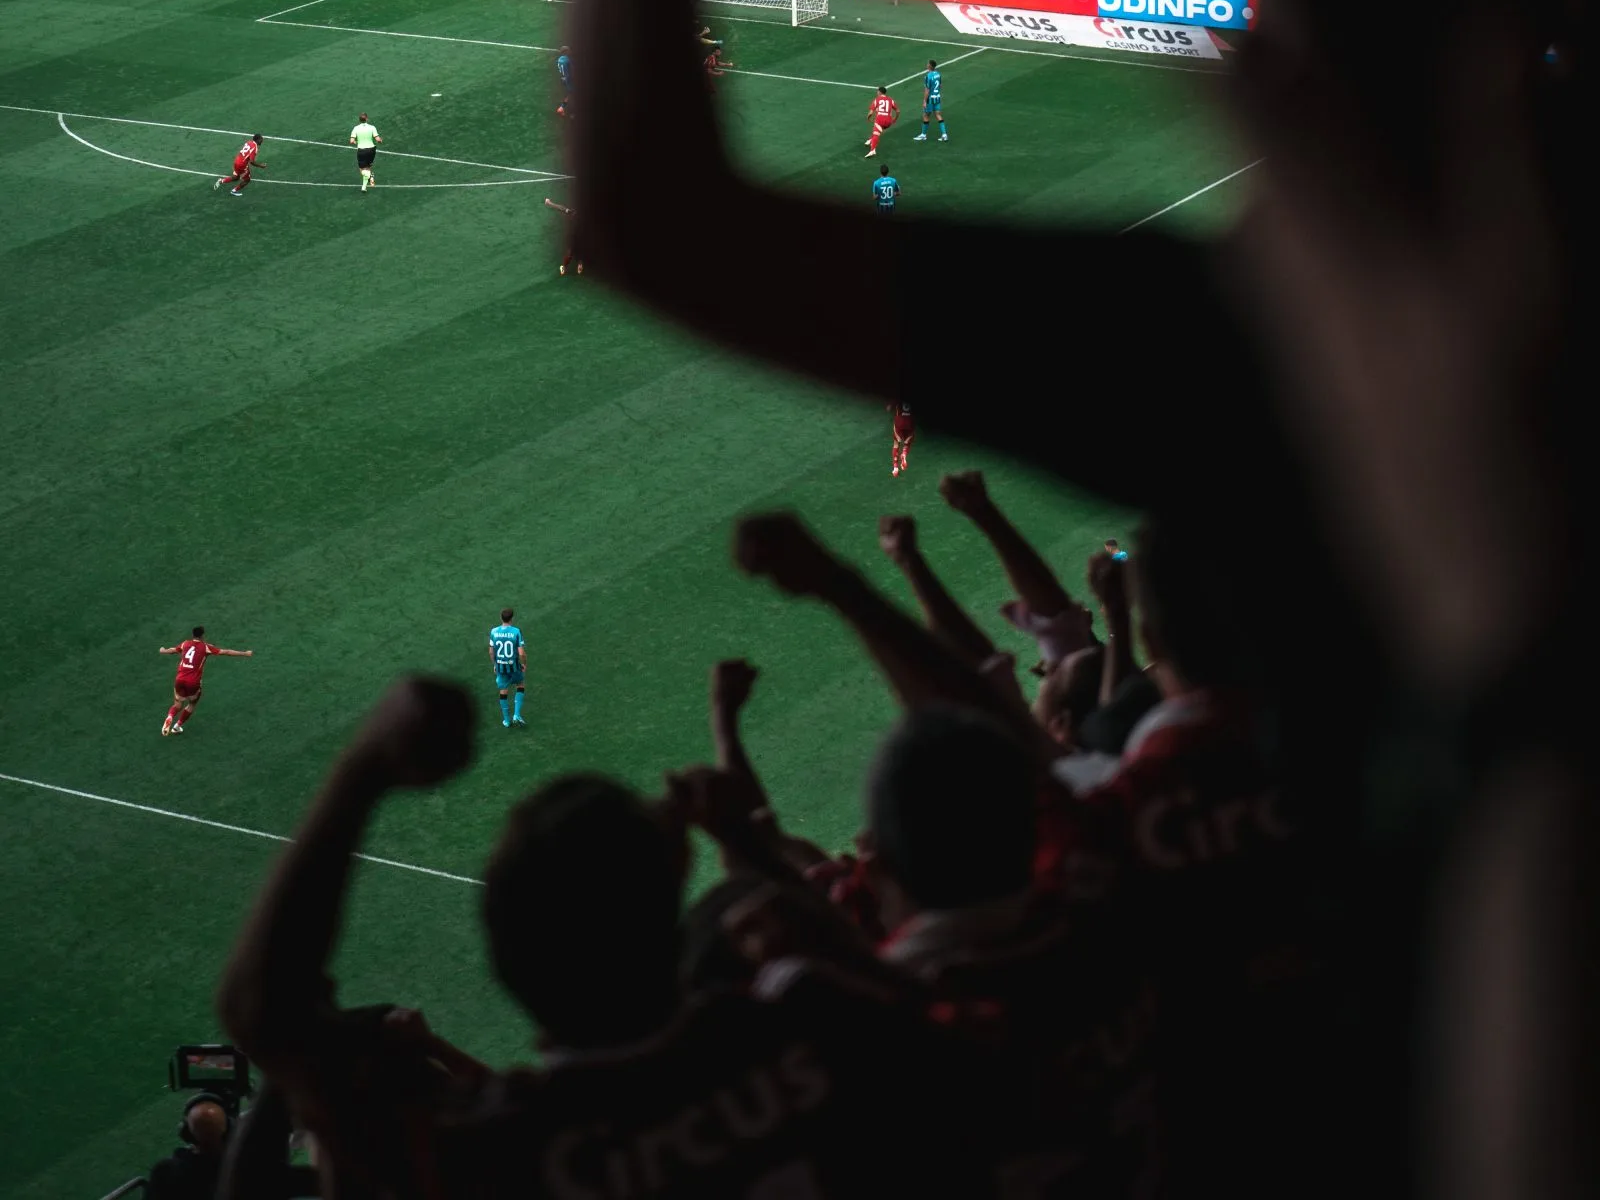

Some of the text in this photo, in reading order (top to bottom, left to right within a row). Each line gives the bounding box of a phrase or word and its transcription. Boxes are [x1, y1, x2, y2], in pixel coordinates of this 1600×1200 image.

[959, 4, 1059, 32] Circus
[976, 27, 1019, 38] CASINO
[1031, 33, 1066, 43] SPORT
[1093, 17, 1193, 46] Circus
[1105, 40, 1201, 57] CASINO & SPORT
[933, 80, 940, 93] 2
[878, 99, 890, 113] 21
[880, 185, 894, 199] 30
[184, 645, 196, 664] 4
[495, 640, 514, 658] 20
[1134, 787, 1298, 869] Circ
